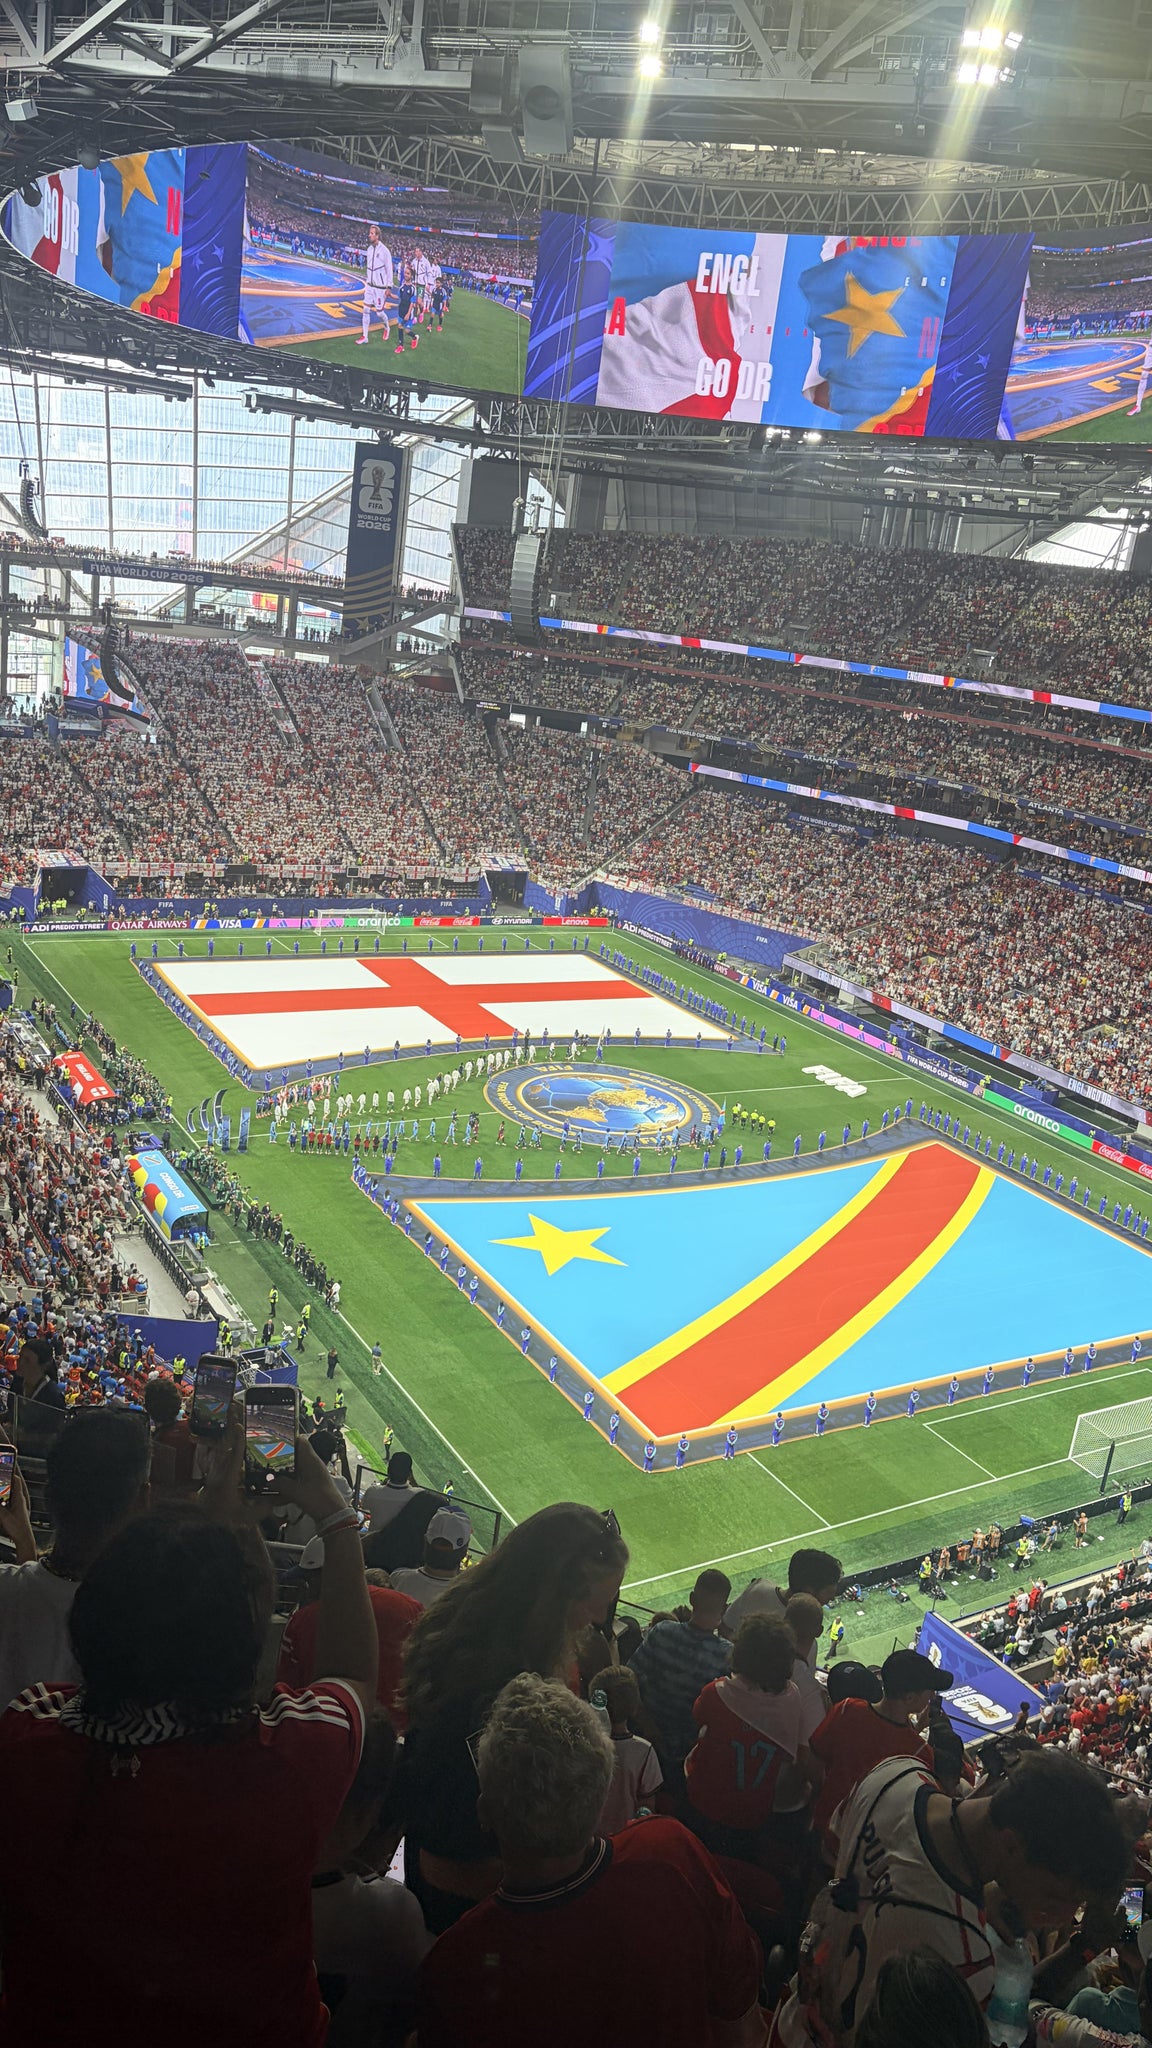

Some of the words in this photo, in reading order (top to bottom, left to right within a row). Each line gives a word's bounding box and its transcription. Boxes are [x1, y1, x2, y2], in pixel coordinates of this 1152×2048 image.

[695, 252, 761, 297] ENGL
[695, 357, 732, 398] GO
[736, 361, 773, 402] DR
[368, 502, 384, 510] FIFA
[357, 513, 379, 521] WORLD
[356, 519, 391, 532] 2026
[90, 563, 112, 574] FIFA
[113, 566, 149, 578] WORLD
[150, 570, 170, 580] CUP
[170, 572, 205, 584] 2026
[802, 753, 839, 766] ATLANTA
[1027, 801, 1065, 816] ATLANTA
[30, 924, 50, 932] ADI
[111, 921, 144, 930] QATAR
[147, 920, 188, 929] AIRWAYS
[218, 919, 242, 929] VISA
[561, 918, 590, 926] Lenovo
[622, 923, 638, 934] ADI
[755, 935, 768, 944] FIFA
[752, 979, 768, 995] VISA
[782, 993, 799, 1010] VISA
[906, 1054, 919, 1065] FIFA
[918, 1059, 937, 1074] WORLD
[937, 1068, 949, 1079] CUP
[1013, 1104, 1060, 1133] aramco
[730, 1740, 777, 1790] 17
